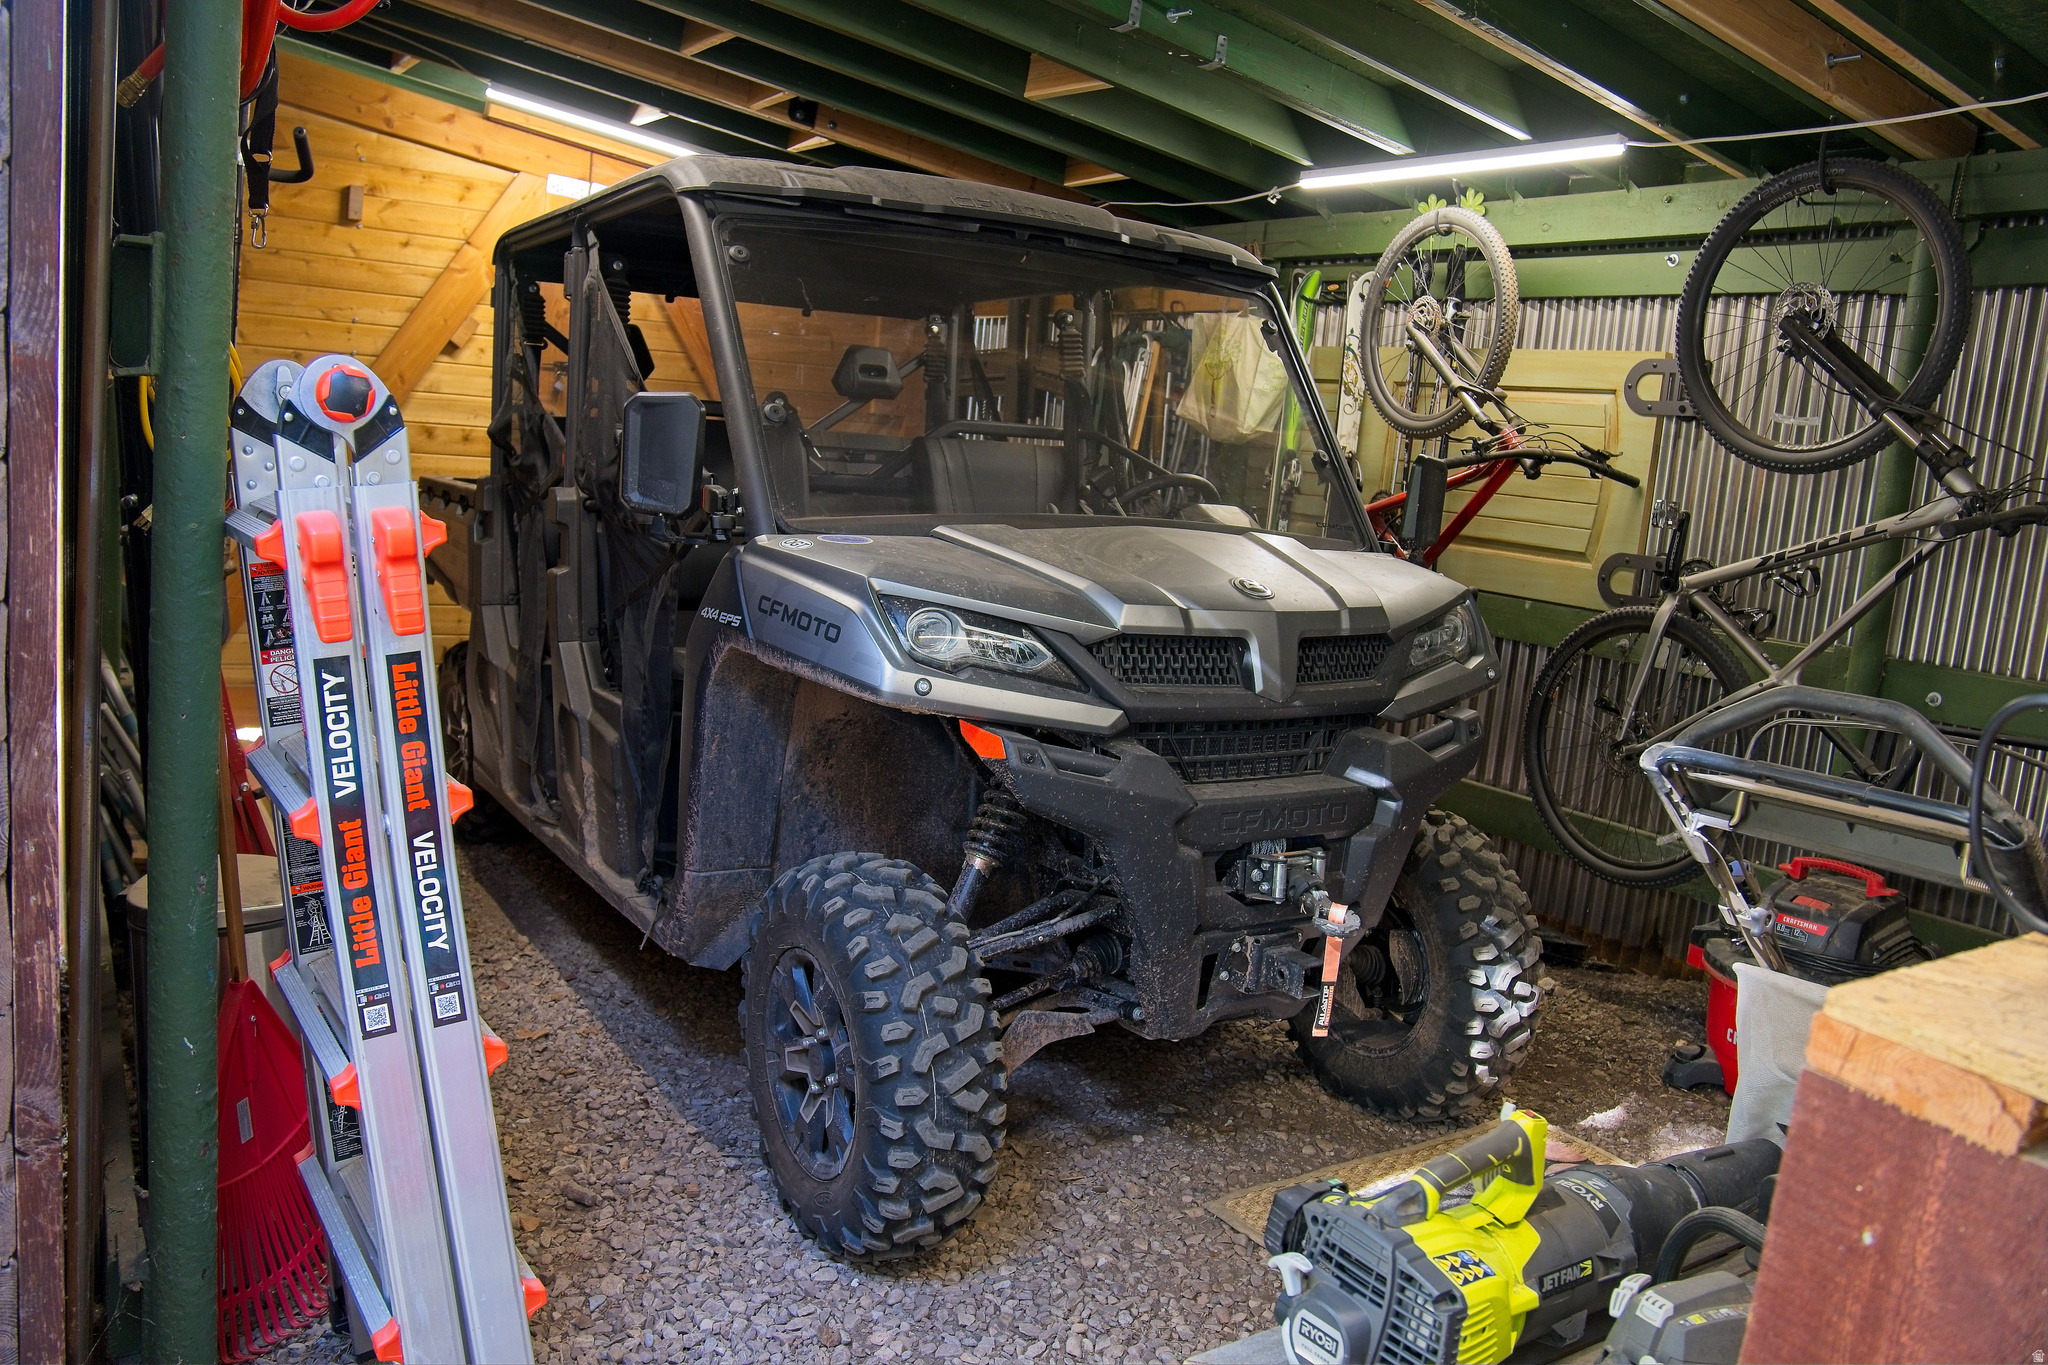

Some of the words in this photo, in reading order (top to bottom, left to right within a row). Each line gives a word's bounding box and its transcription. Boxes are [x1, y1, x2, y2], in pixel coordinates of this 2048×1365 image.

[1761, 178, 1789, 199] XR2
[1792, 168, 1845, 184] BONRAGER
[950, 195, 1084, 226] CFMOTO
[718, 611, 742, 627] EPS
[757, 594, 842, 644] CFMOTO
[391, 661, 421, 734] Little
[321, 671, 357, 799] VELOCITY
[400, 740, 431, 812] Giant
[1219, 802, 1348, 836] CFMOTO
[337, 818, 369, 890] Giant
[302, 882, 323, 891] WARNIN
[412, 830, 450, 951] VELOCITY
[348, 895, 380, 968] Little
[1782, 916, 1818, 931] CRAFTSMAN
[1555, 1179, 1605, 1211] RYOBI
[1541, 1271, 1560, 1293] JET
[1560, 1264, 1581, 1286] FAN
[1300, 1320, 1337, 1355] RYOBI
